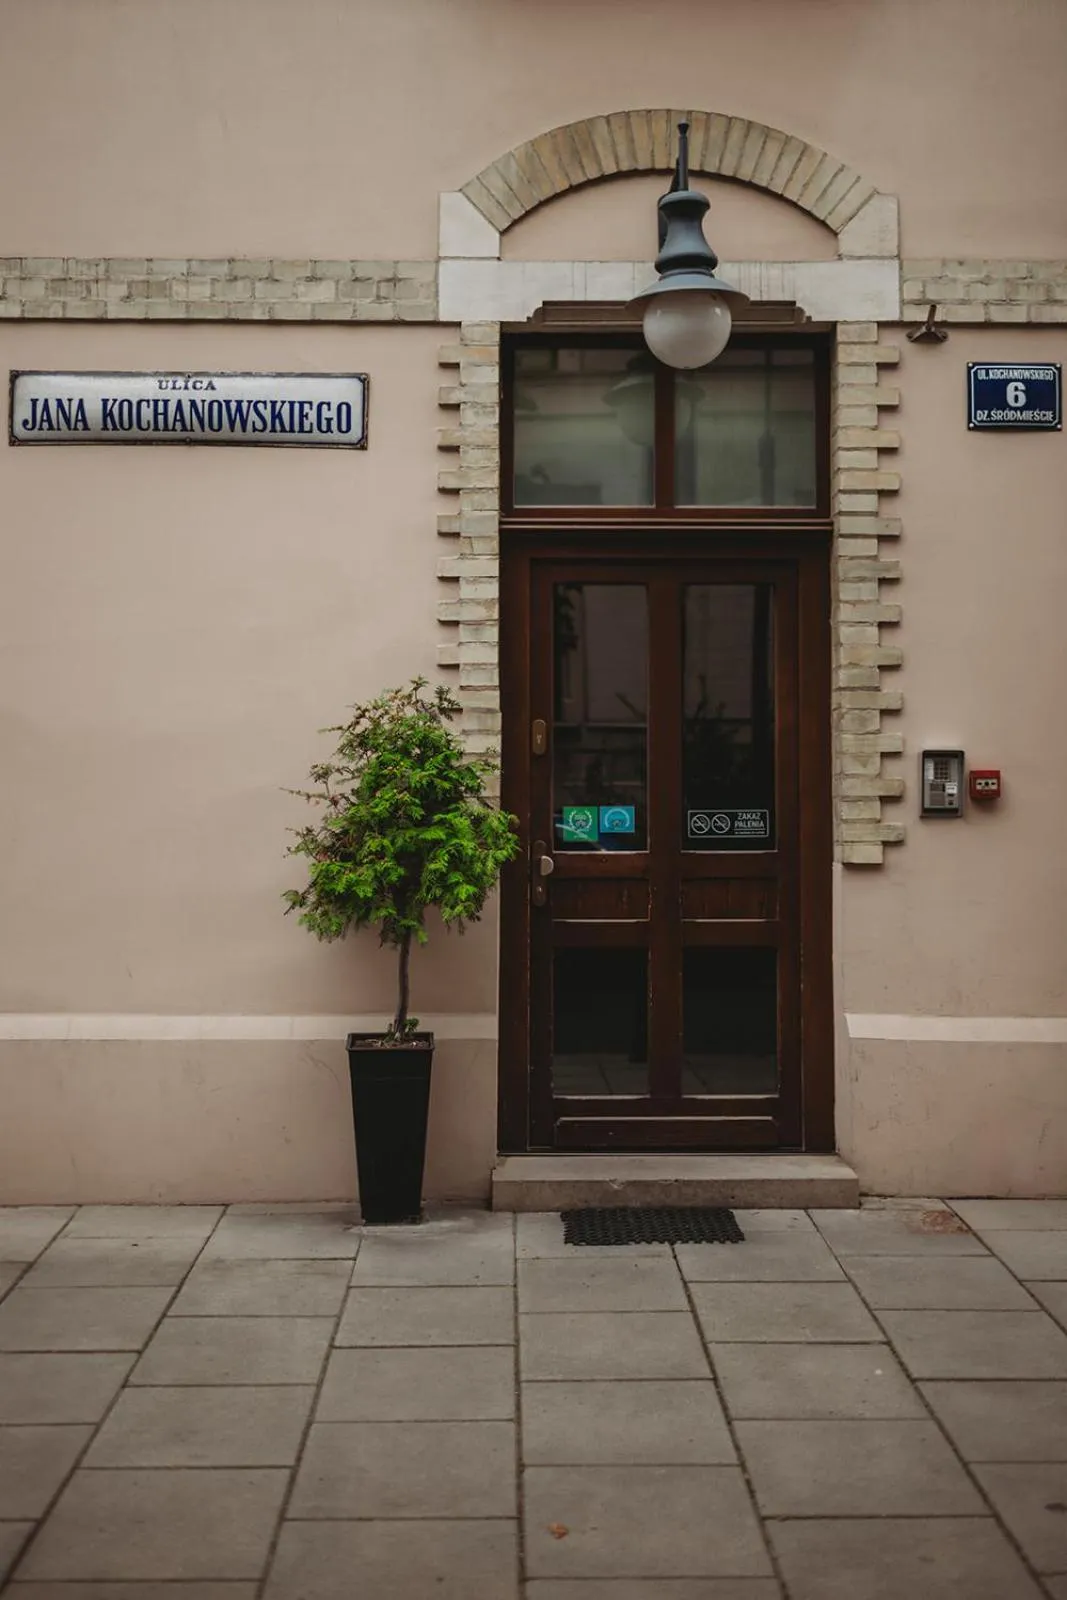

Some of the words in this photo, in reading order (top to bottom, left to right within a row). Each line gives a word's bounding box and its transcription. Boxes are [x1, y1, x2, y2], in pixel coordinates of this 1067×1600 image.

[157, 379, 217, 391] ULICA
[1006, 381, 1027, 408] 6
[22, 398, 91, 432] JANA
[101, 398, 352, 435] KOCHANOWSKIEGO
[737, 812, 761, 820] ZAKAZ
[734, 820, 765, 828] PALENIA
